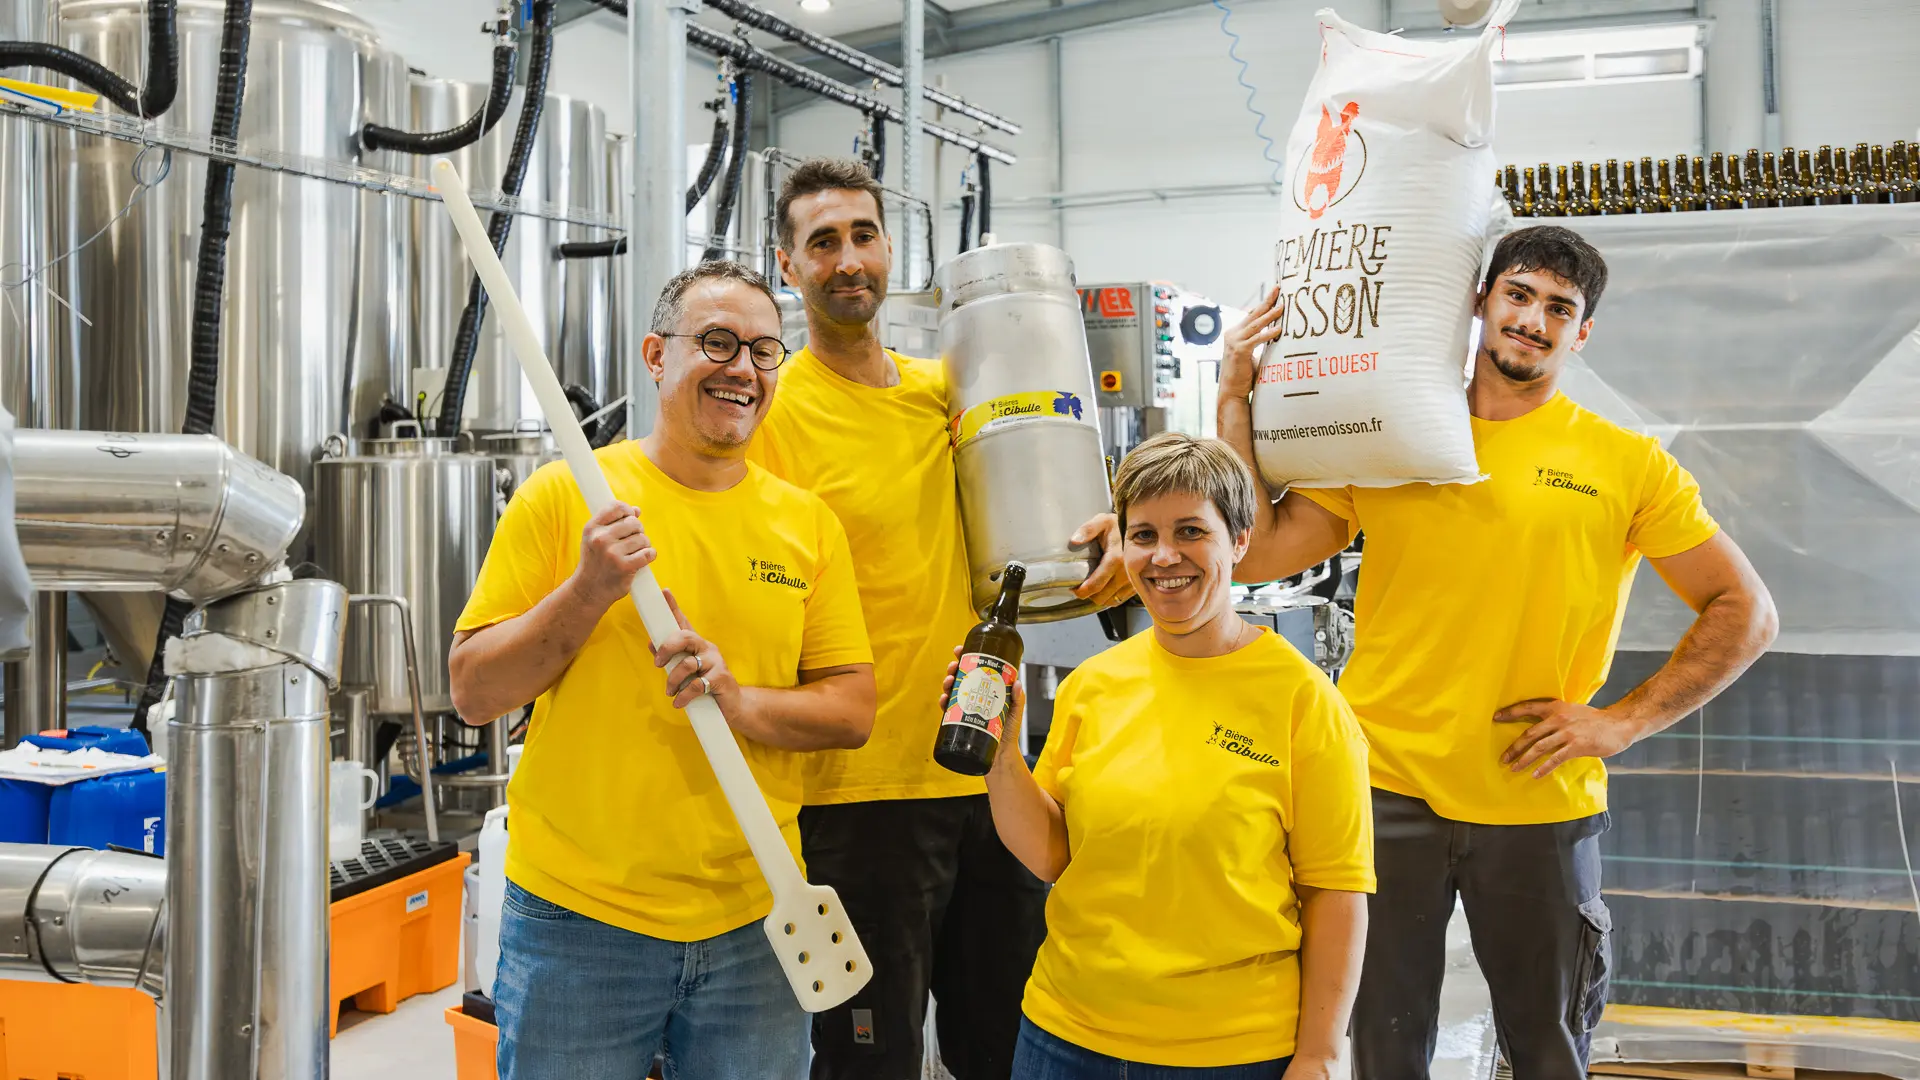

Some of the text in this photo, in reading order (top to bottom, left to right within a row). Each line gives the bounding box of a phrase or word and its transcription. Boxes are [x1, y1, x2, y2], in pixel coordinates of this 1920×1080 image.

[1276, 219, 1392, 283] REMIÈRE
[1268, 276, 1384, 344] OISSON
[1257, 352, 1379, 384] ALTERIE DE L'OUEST
[1003, 404, 1042, 416] Cibulle
[1253, 417, 1383, 443] www.premieremoisson.fr
[1547, 468, 1574, 480] Bières
[1551, 477, 1599, 497] Cibulle
[760, 560, 786, 572] Bières
[766, 571, 808, 590] Cibulle
[1225, 729, 1254, 746] Bières
[1226, 741, 1280, 767] Cibulle
